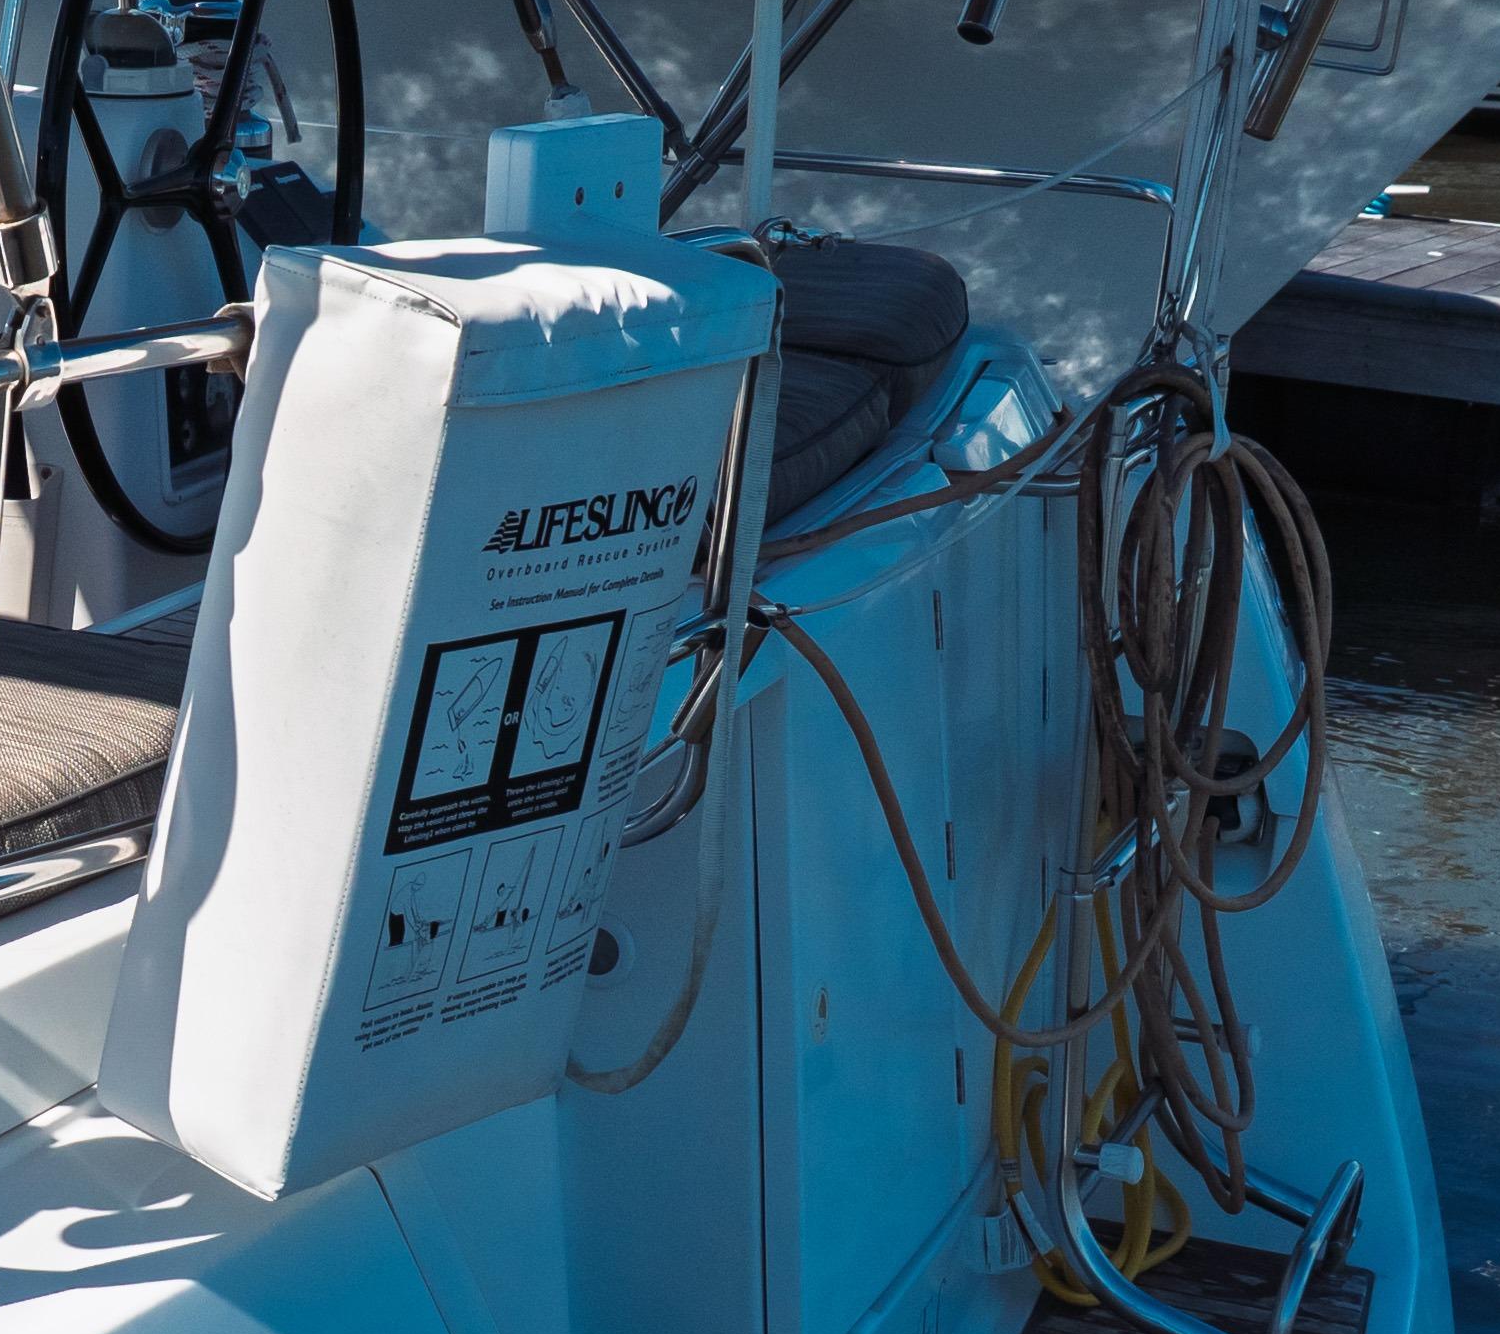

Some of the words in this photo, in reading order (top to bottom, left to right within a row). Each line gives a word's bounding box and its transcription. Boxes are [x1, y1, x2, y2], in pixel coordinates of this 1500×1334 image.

[486, 557, 569, 581] Overboard
[577, 549, 629, 568] Rescue
[636, 535, 680, 557] System
[489, 598, 505, 611] See
[507, 591, 552, 608] Instruction
[553, 586, 586, 604] Manual
[586, 582, 600, 598] for
[602, 575, 639, 595] Complete
[503, 711, 520, 727] OR
